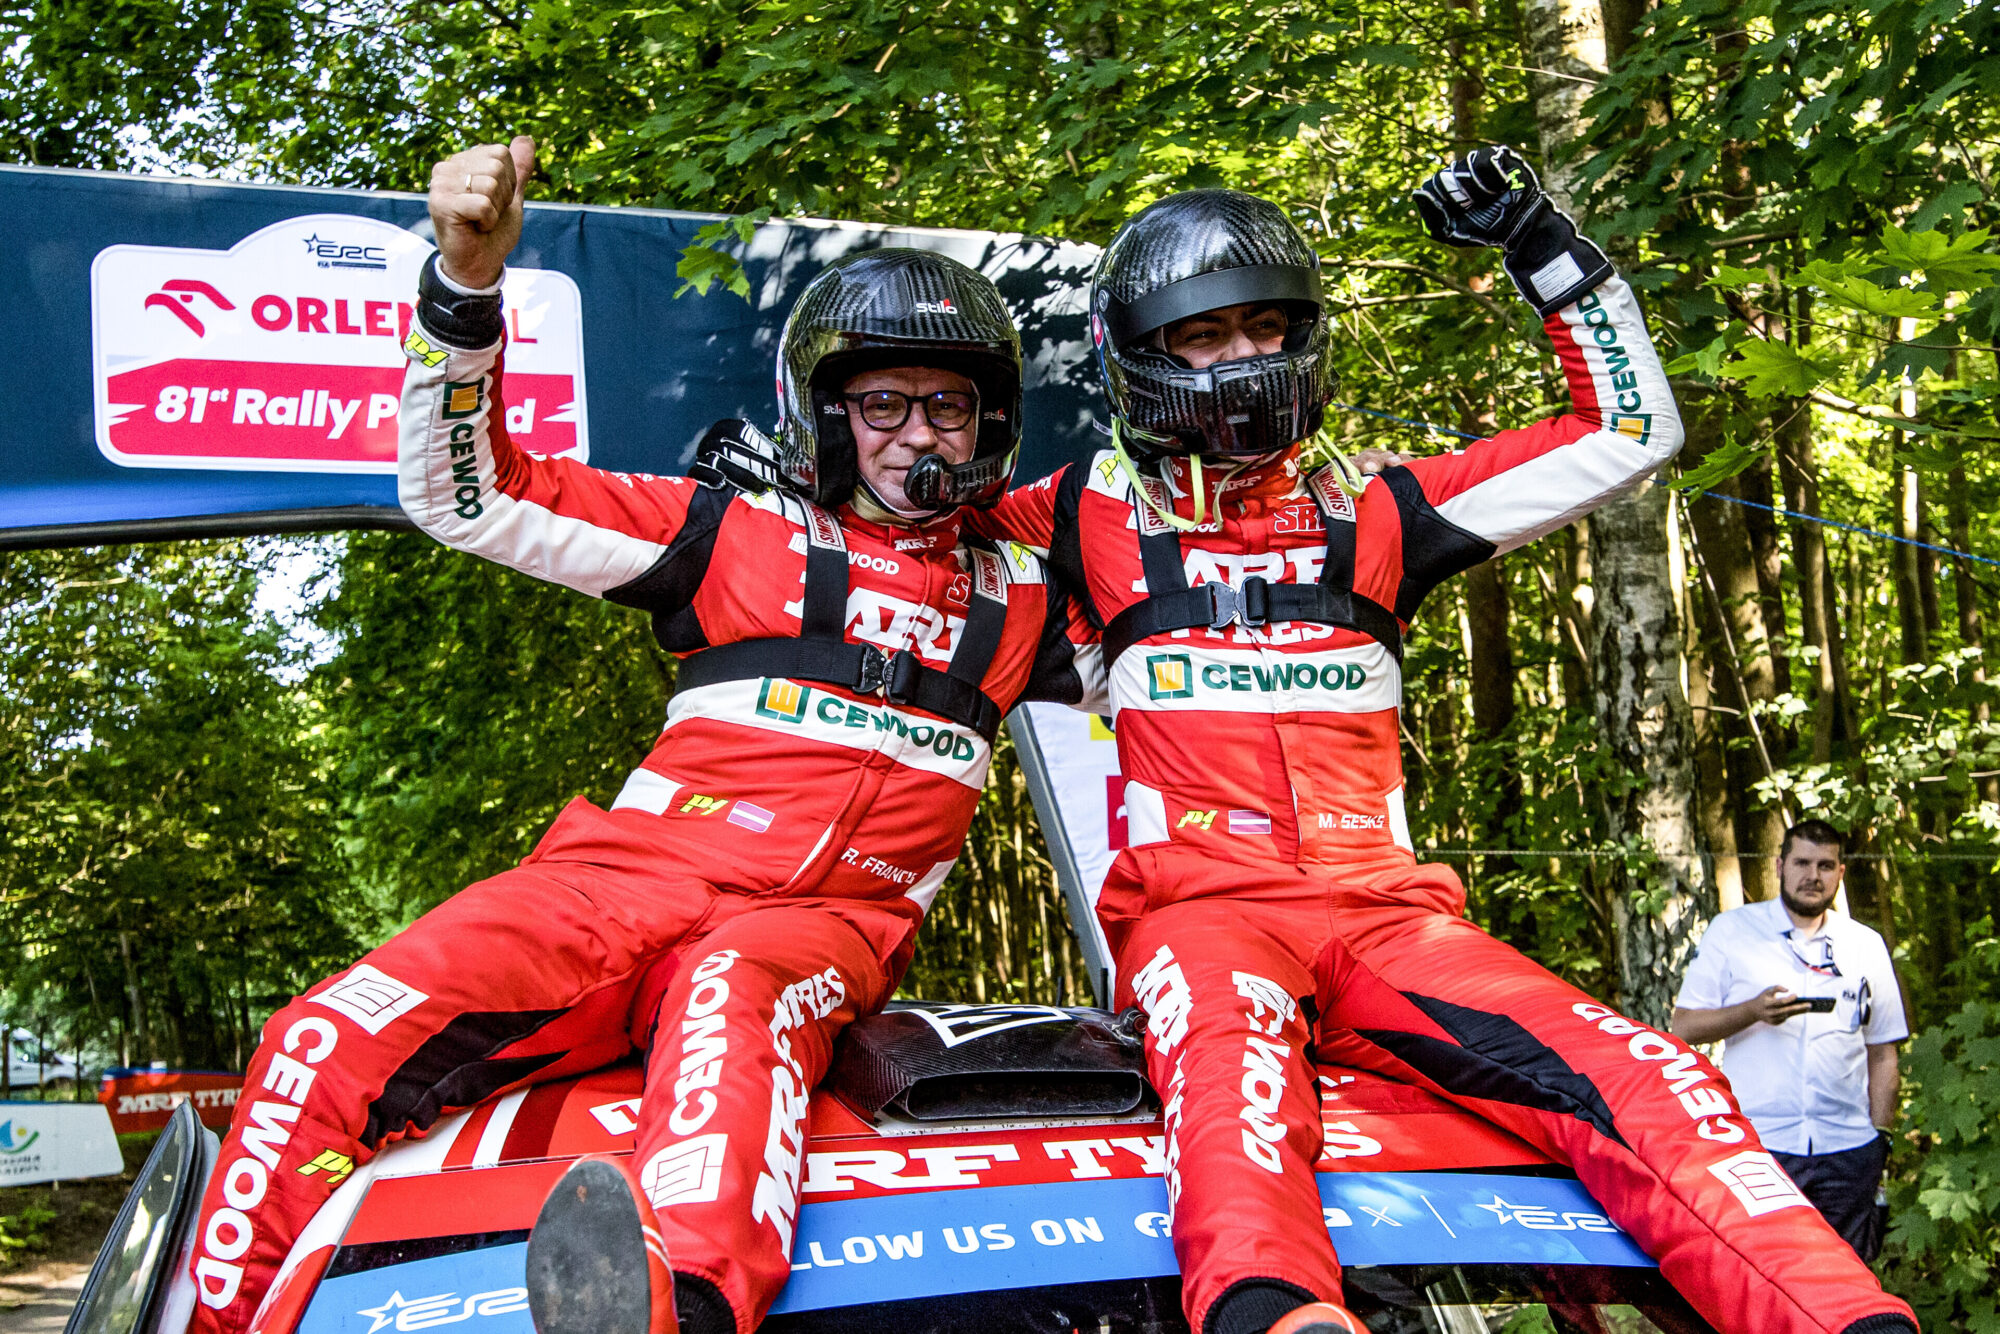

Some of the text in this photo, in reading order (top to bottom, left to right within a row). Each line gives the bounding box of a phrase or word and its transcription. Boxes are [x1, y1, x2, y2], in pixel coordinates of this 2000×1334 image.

[308, 239, 386, 261] ERC
[1577, 290, 1642, 413] CEWOOD
[154, 386, 230, 424] 81st
[233, 388, 361, 440] Rally
[847, 551, 899, 575] WOOD
[1201, 663, 1366, 691] CEWOOD
[817, 697, 975, 761] CEWOOD
[1318, 813, 1336, 829] M.
[840, 847, 860, 866] R.
[195, 1016, 339, 1310] CEWOOD
[802, 1143, 1020, 1193] RF
[942, 1223, 1016, 1254] US
[1031, 1216, 1105, 1246] ON
